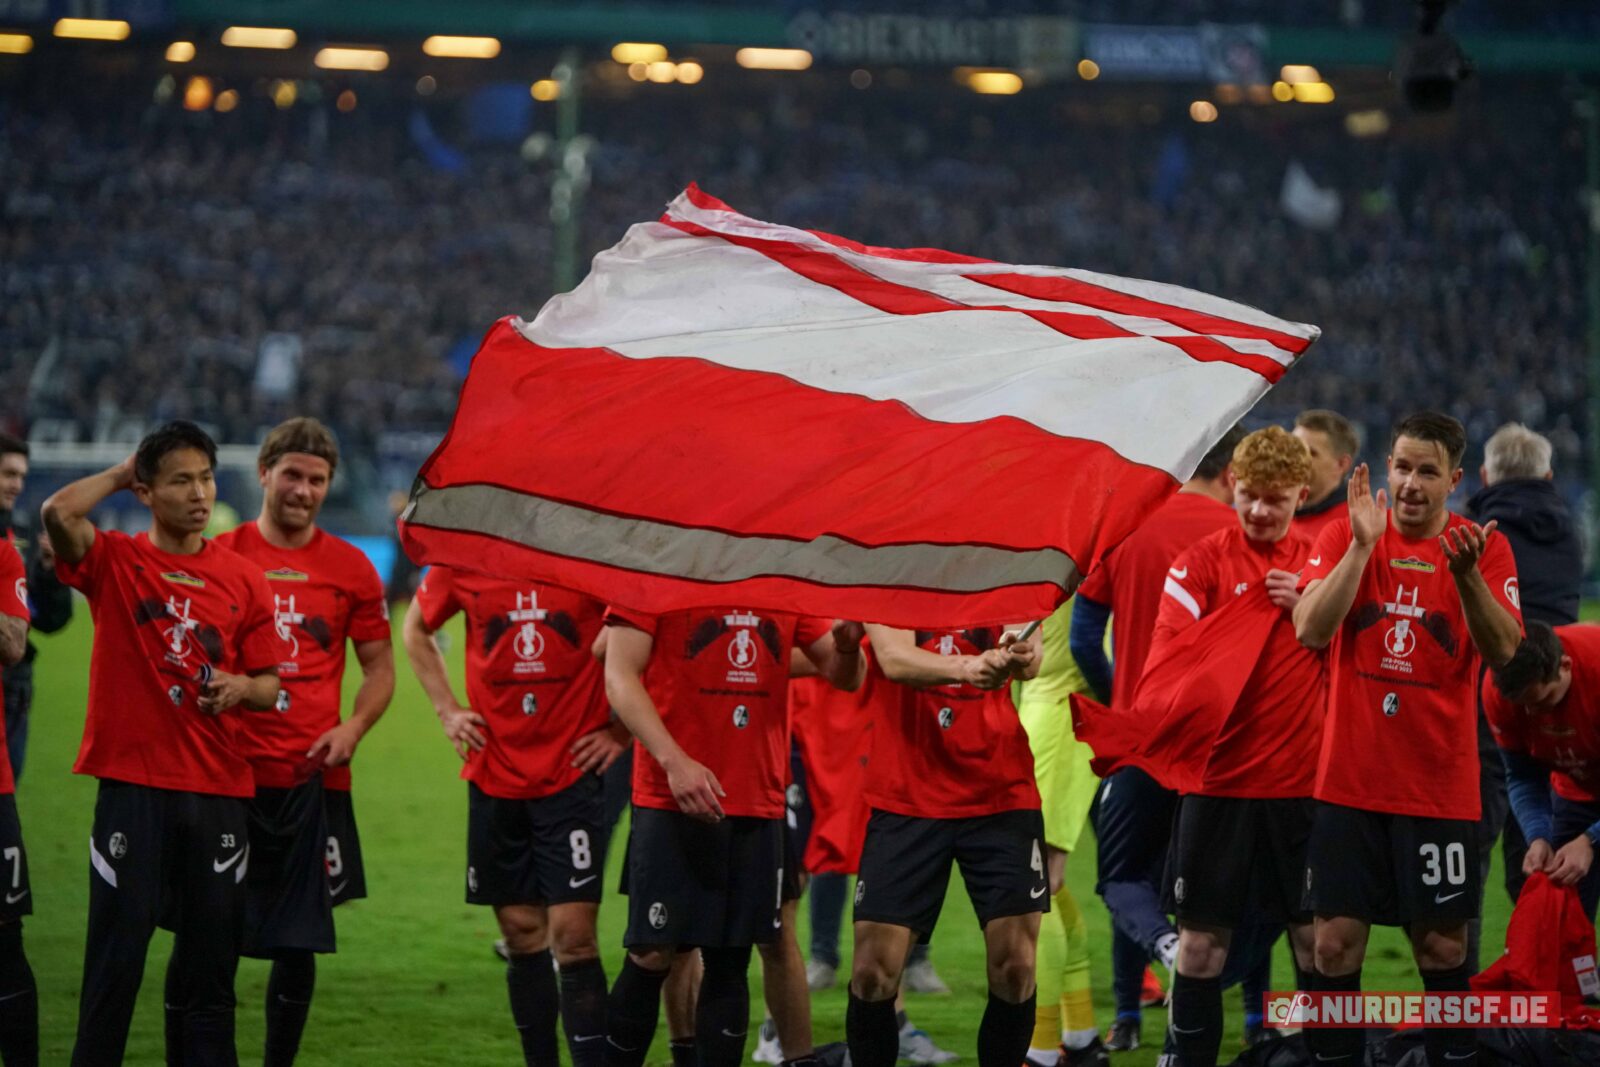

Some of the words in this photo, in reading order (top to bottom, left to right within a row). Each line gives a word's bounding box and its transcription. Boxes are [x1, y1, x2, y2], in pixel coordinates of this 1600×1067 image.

[221, 833, 236, 848] 33
[569, 829, 592, 870] 8
[1030, 838, 1044, 880] 4
[1419, 842, 1466, 886] 30
